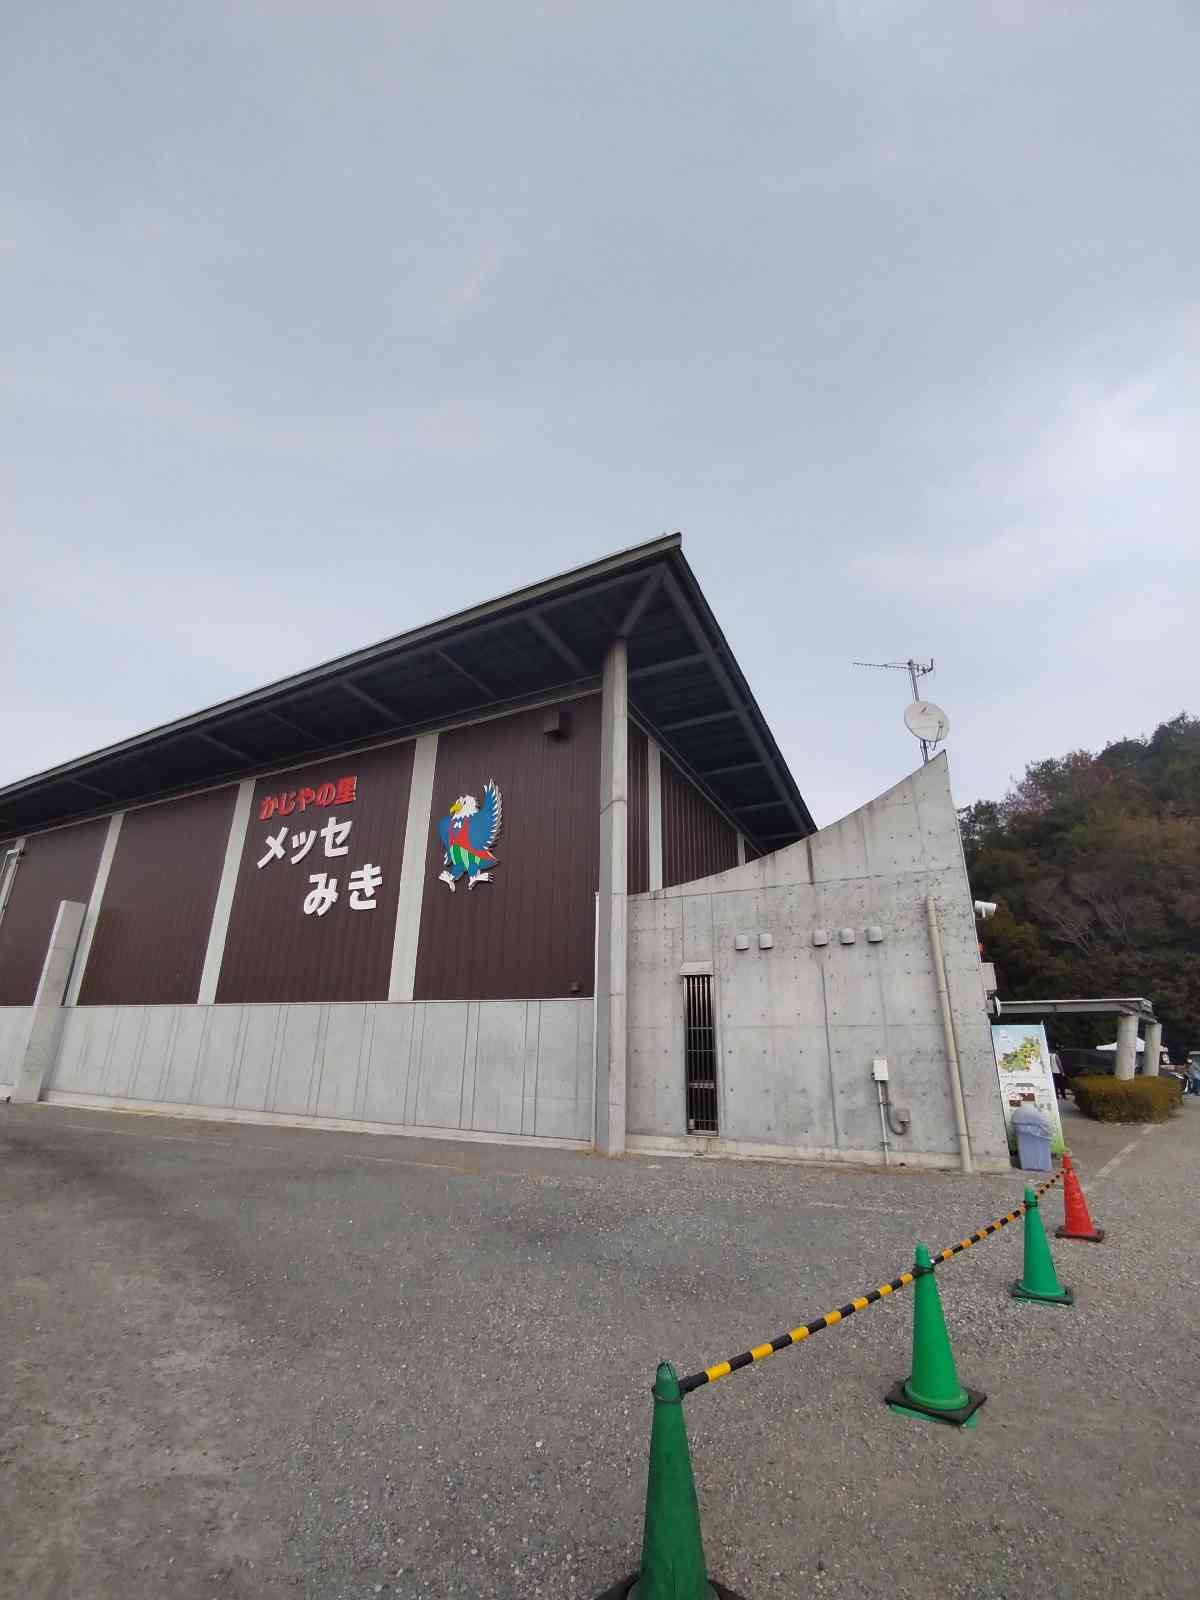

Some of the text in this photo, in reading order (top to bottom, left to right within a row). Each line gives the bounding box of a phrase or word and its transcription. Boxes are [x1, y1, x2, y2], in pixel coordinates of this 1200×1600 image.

[260, 776, 357, 820] かじやの里
[257, 816, 352, 869] メッセ
[303, 863, 383, 916] みき
